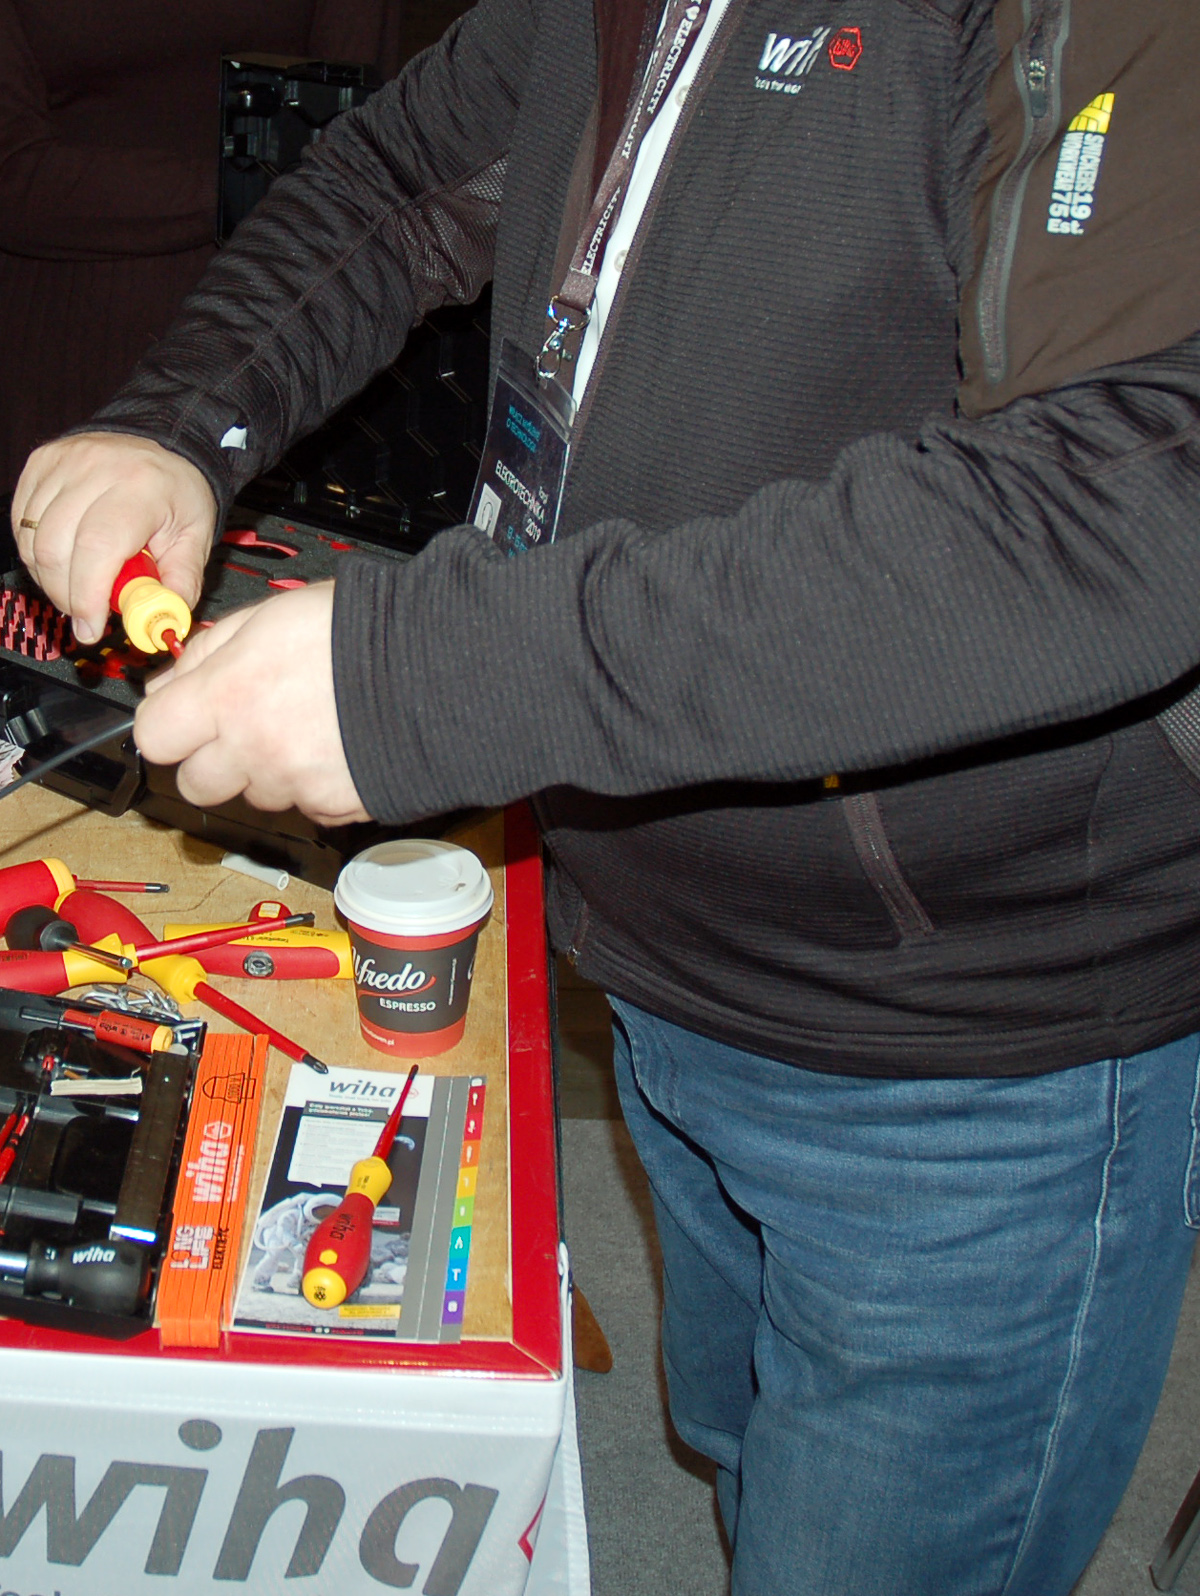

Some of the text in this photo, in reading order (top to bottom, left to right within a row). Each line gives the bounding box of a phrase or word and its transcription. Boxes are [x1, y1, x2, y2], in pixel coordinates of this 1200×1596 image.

[647, 18, 693, 114] ELECTRICITY
[1048, 132, 1084, 218] WORKWEAR 75
[1070, 133, 1105, 220] SNICKERS 19
[1046, 218, 1085, 236] Est.
[525, 518, 542, 543] 2019
[379, 997, 436, 1013] ESPRESSO
[329, 1078, 396, 1099] wiha
[185, 1140, 230, 1202] wiha
[330, 1213, 355, 1241] wiha
[72, 1246, 116, 1264] wiha
[170, 1225, 195, 1269] LONG
[189, 1225, 214, 1269] LIFE
